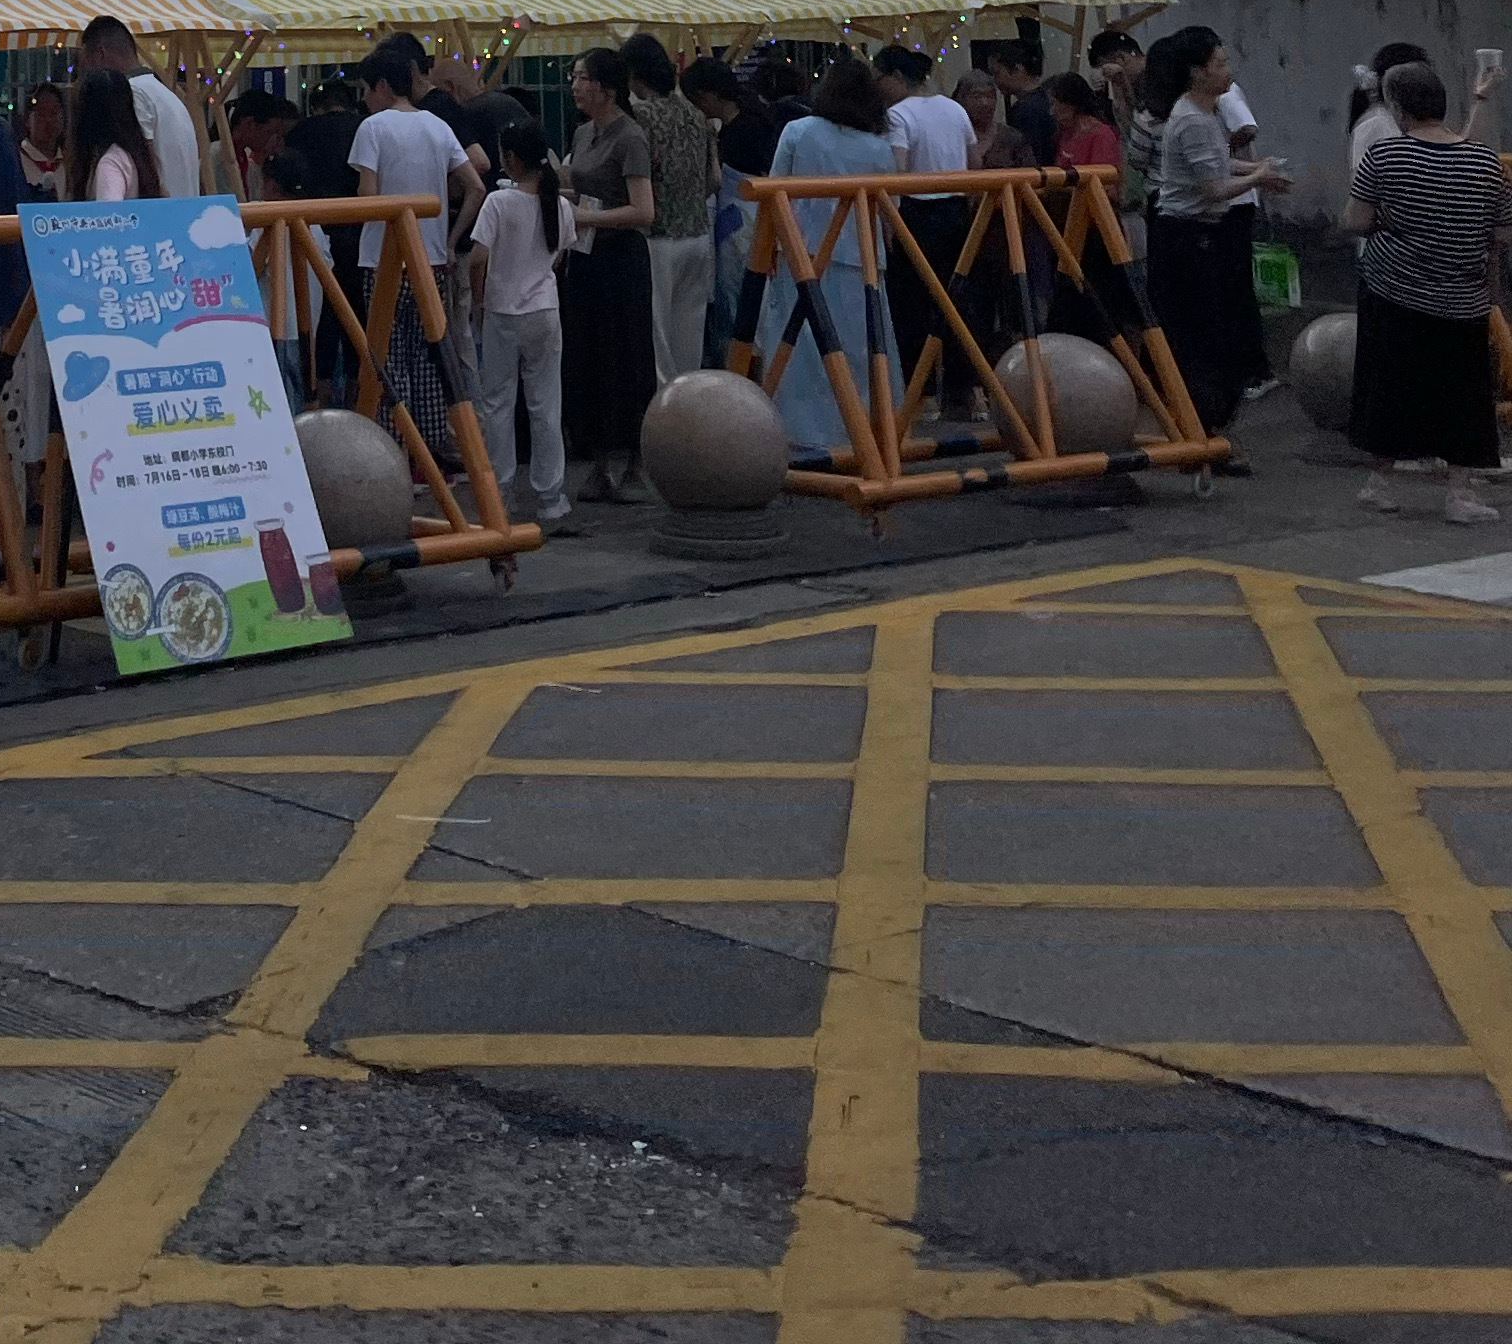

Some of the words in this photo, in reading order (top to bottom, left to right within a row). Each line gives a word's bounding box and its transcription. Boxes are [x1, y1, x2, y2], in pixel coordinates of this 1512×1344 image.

[62, 238, 185, 285] 小满童年
[132, 396, 225, 429] 爱心义卖
[177, 526, 242, 551] 每份2元起
